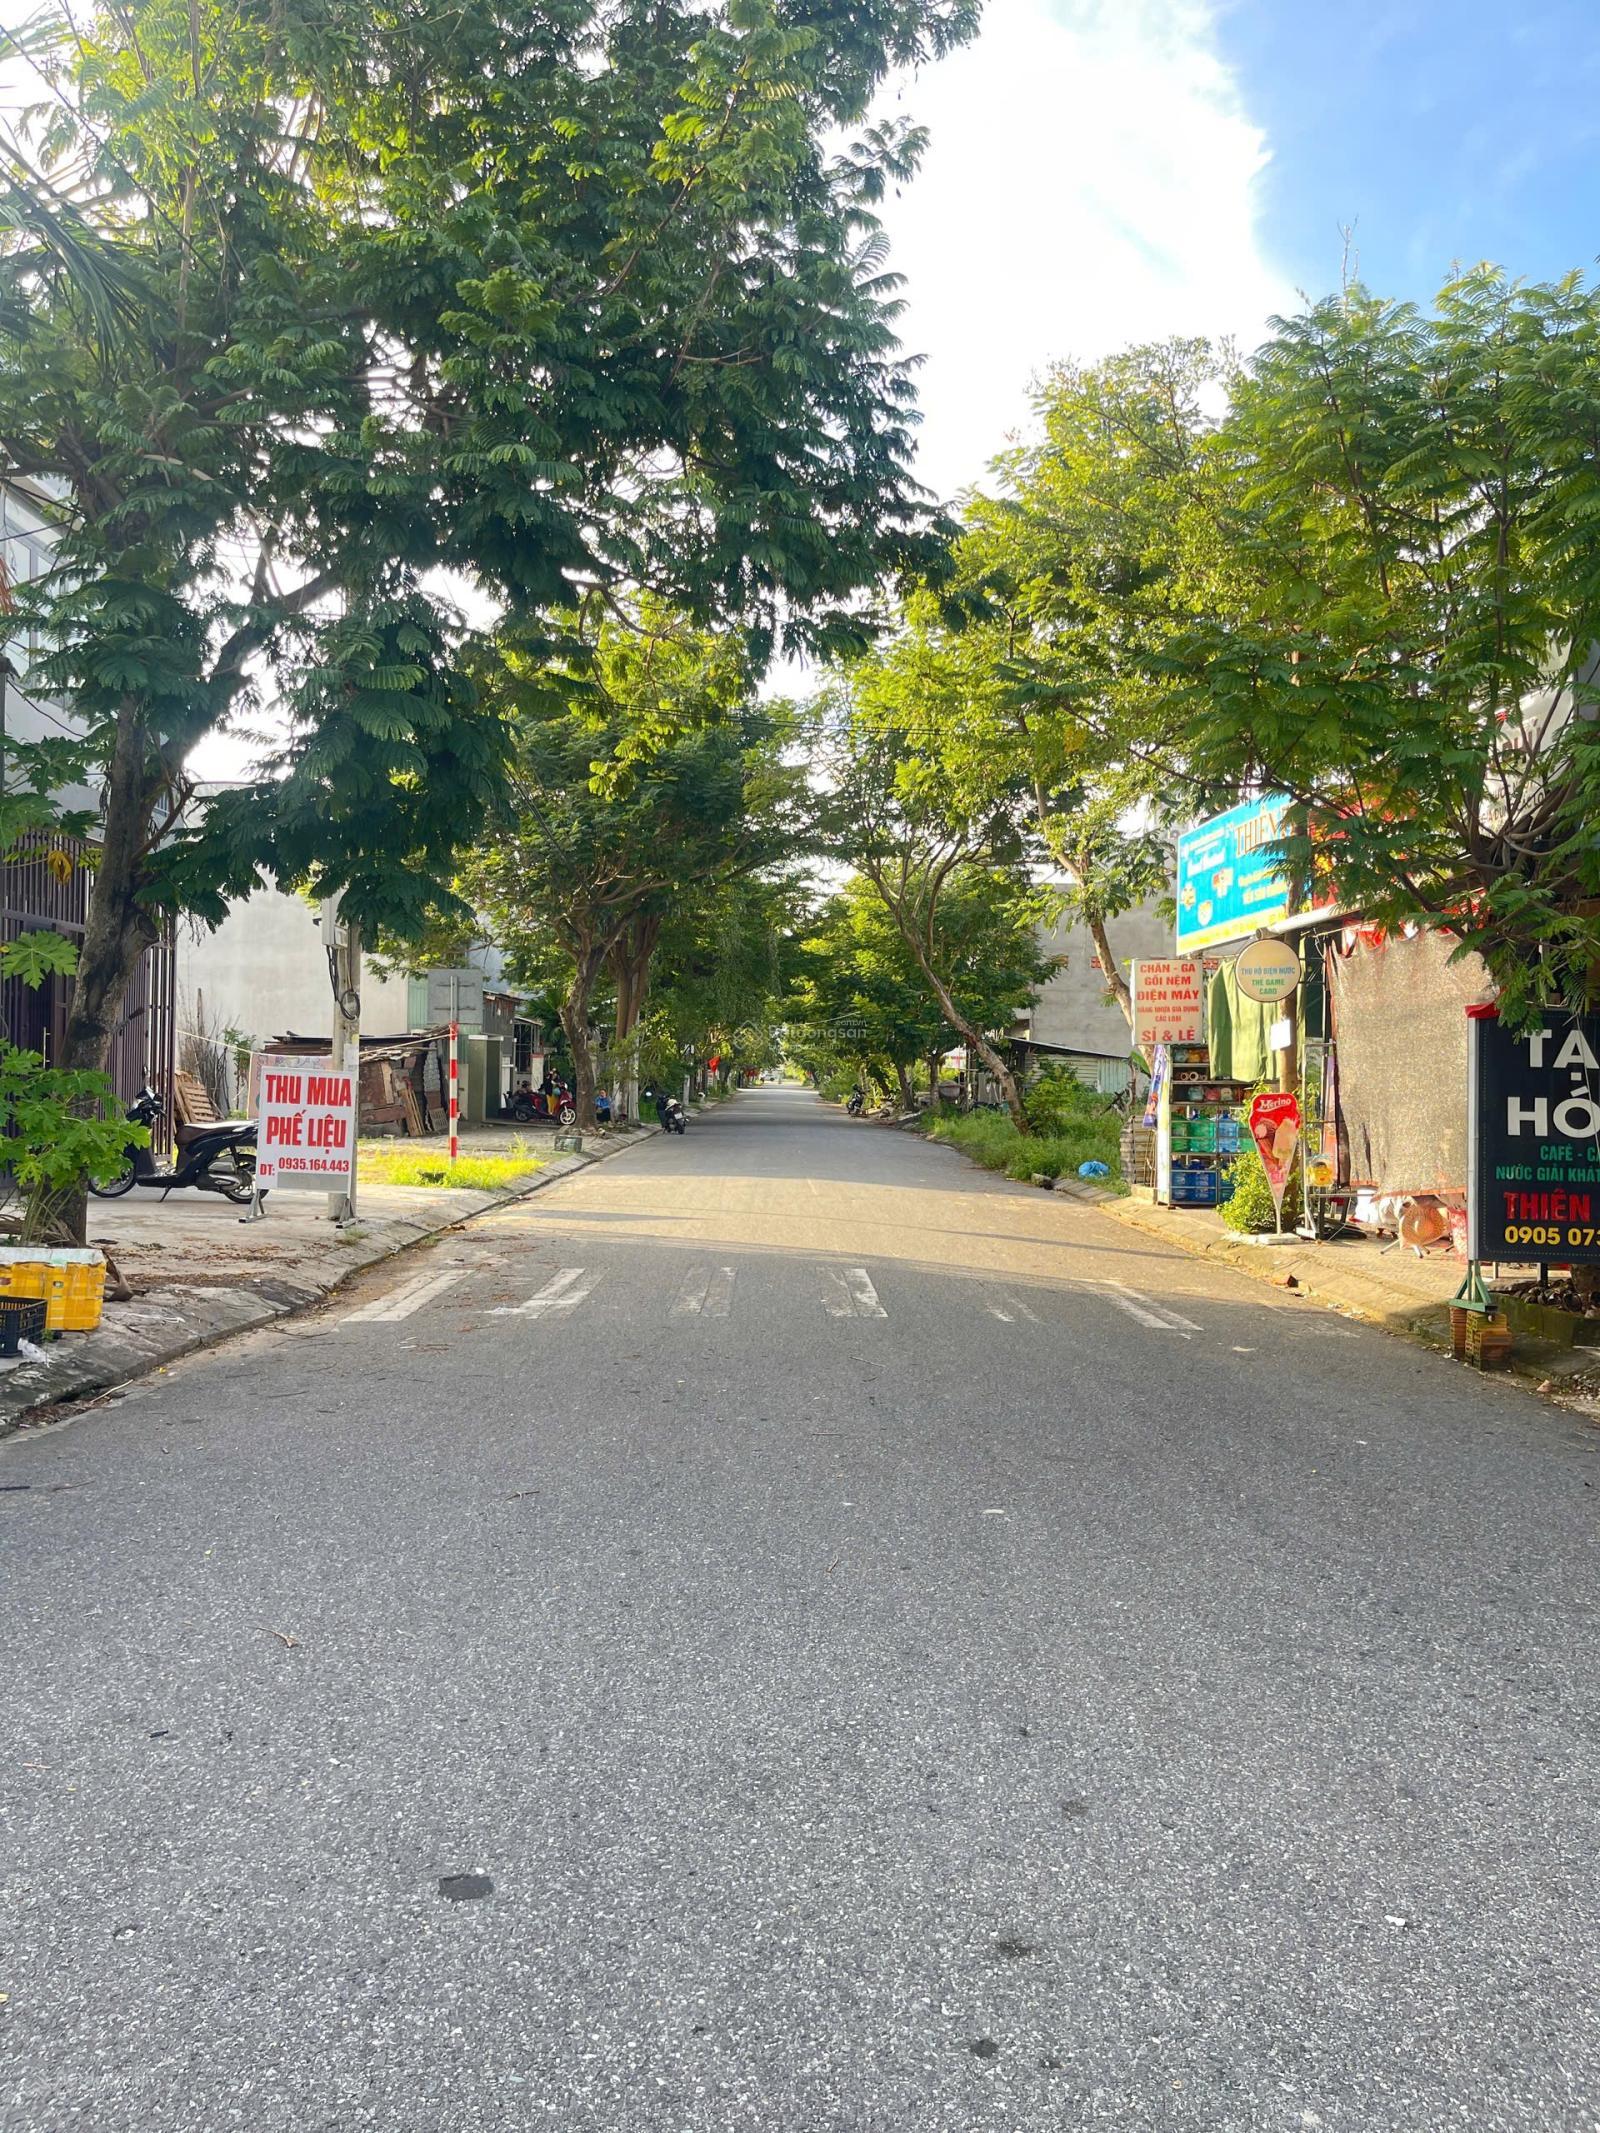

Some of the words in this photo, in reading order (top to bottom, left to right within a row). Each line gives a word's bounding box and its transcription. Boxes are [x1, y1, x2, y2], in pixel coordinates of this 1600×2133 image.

[1181, 963, 1196, 973] GA
[1265, 978, 1285, 986] GAME
[1162, 1030, 1173, 1042] &
[265, 1074, 302, 1105] THU
[306, 1076, 352, 1107] MUA
[1259, 1097, 1292, 1110] Merino
[266, 1109, 306, 1146] PHẾ
[307, 1113, 347, 1155] LIỆU
[278, 1157, 350, 1172] 0935.164.443
[1495, 1164, 1532, 1181] NƯỚC
[1503, 1188, 1591, 1222] THIÊN
[1504, 1226, 1561, 1246] 0905
